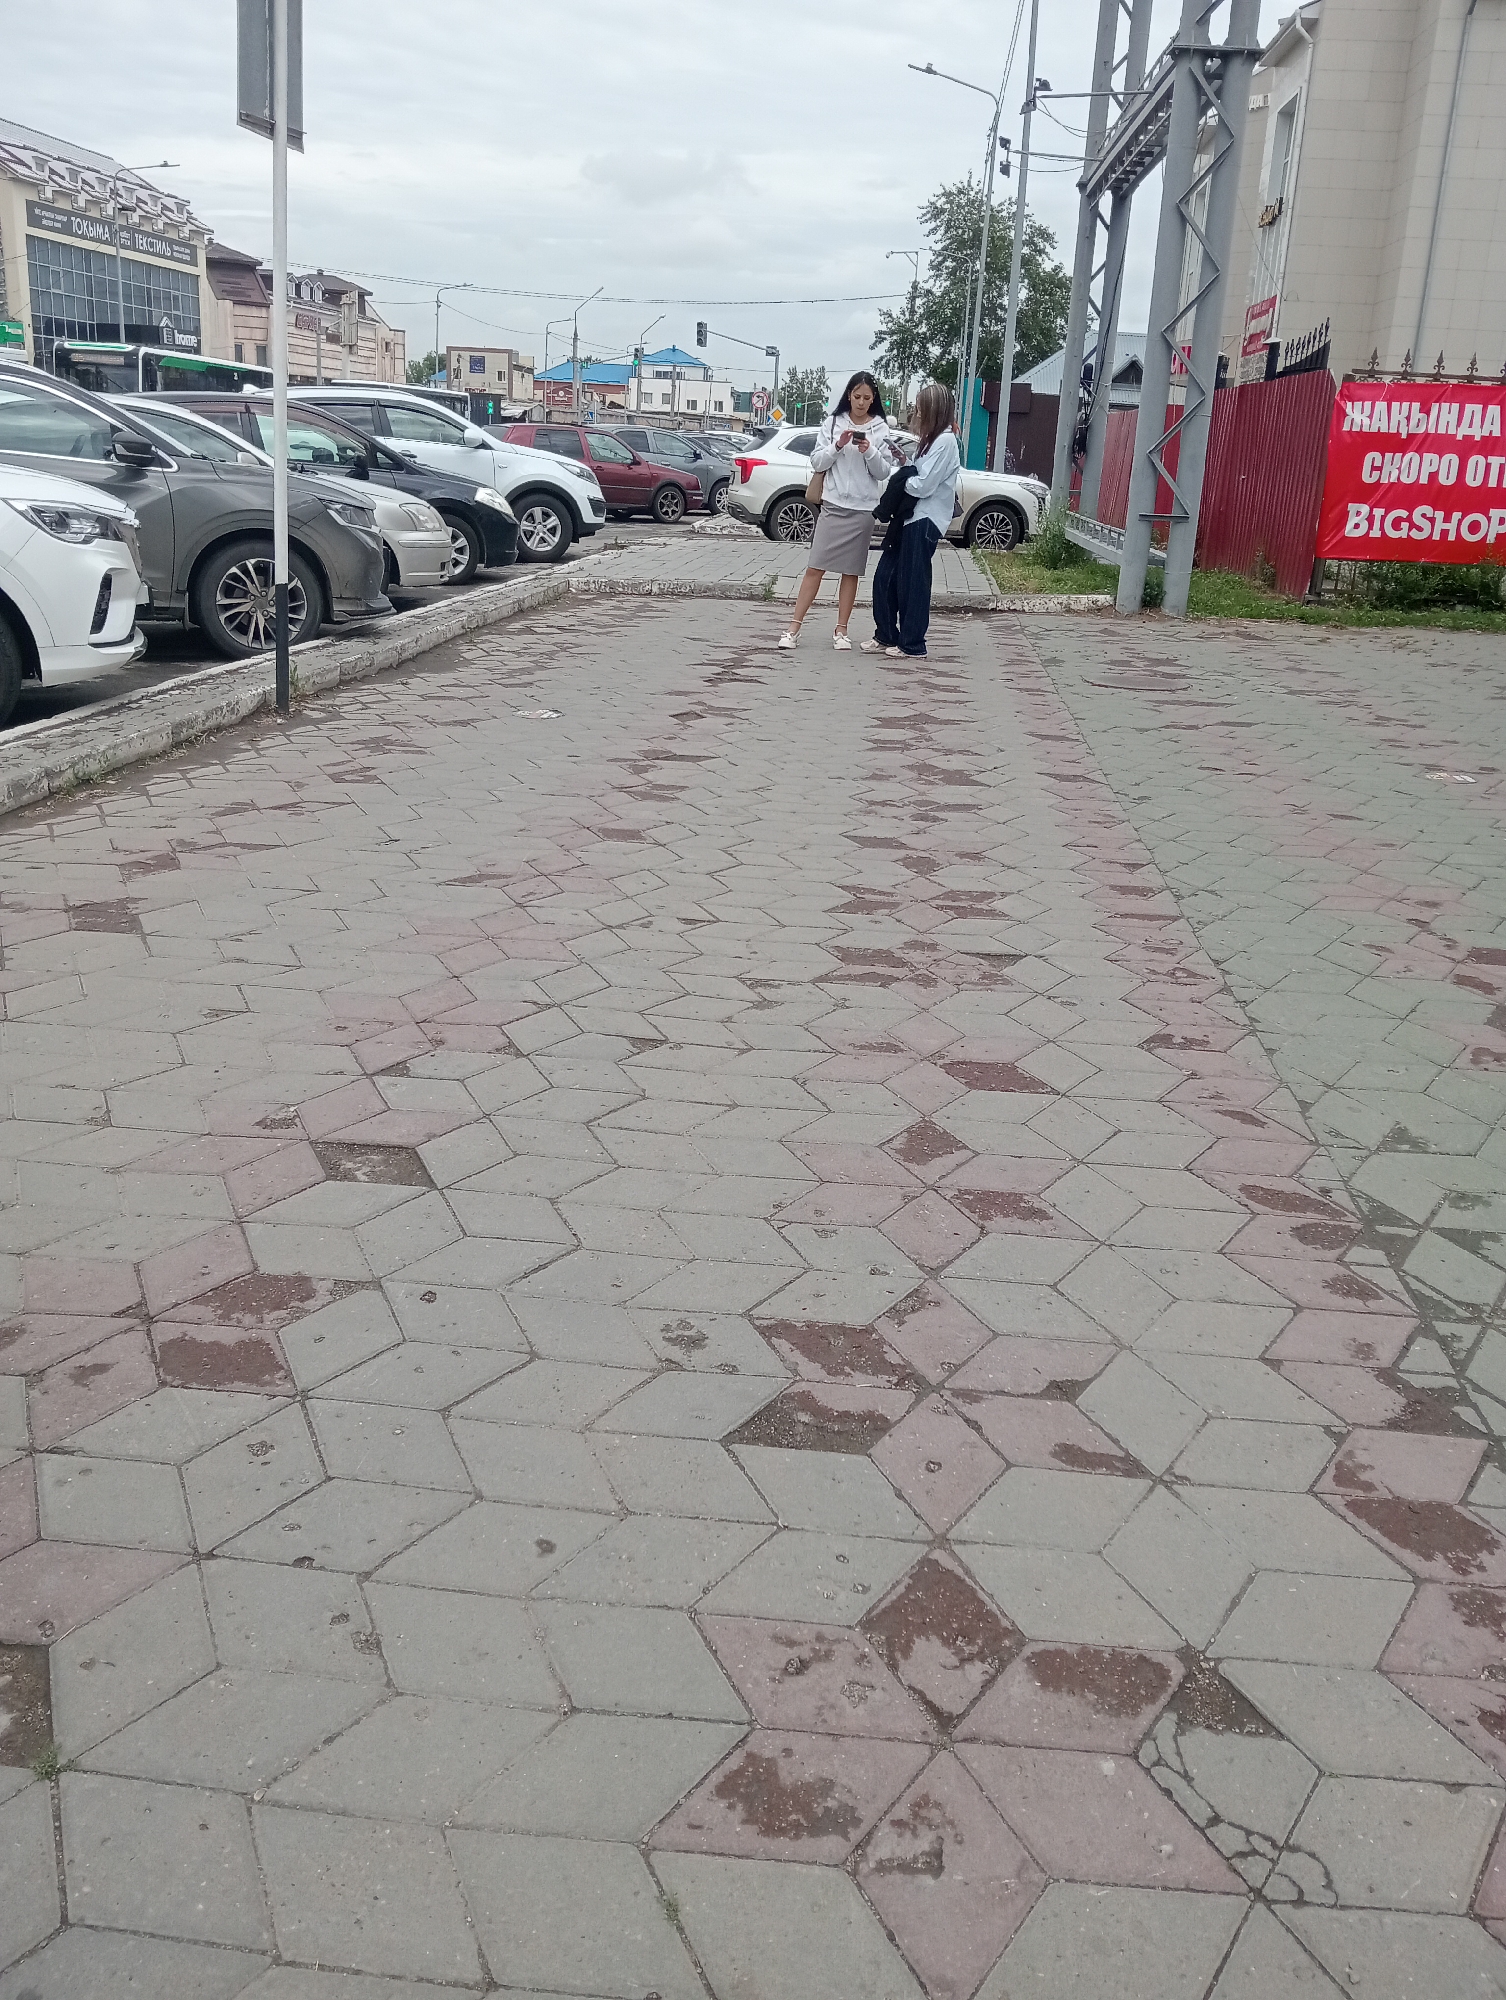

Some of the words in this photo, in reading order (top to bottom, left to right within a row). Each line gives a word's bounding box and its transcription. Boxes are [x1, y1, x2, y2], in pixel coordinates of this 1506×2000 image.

[70, 216, 111, 242] ТОҚЫМА
[134, 232, 172, 257] ТЕКСТИЛЬ
[174, 329, 198, 348] home
[1342, 401, 1501, 441] ЖАҚЫНДА
[1361, 452, 1460, 486] СКОРО
[1465, 454, 1506, 488] ОТ
